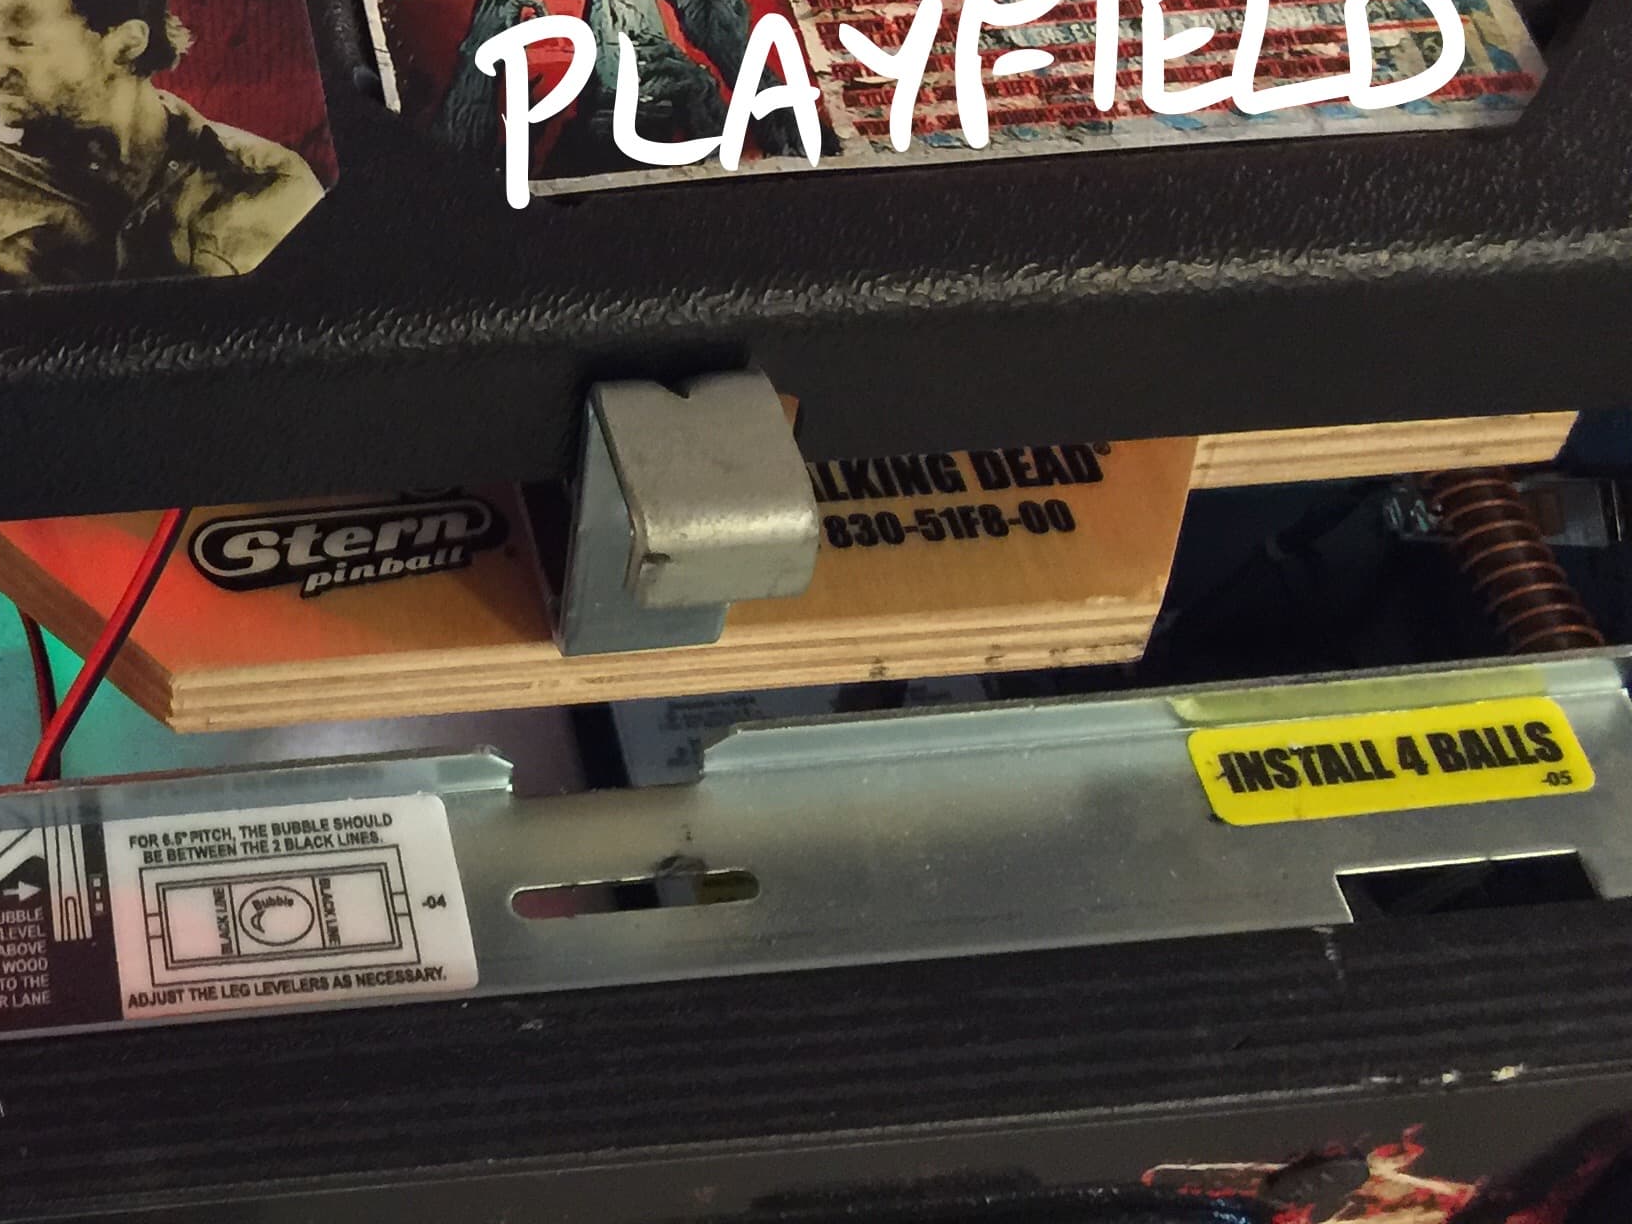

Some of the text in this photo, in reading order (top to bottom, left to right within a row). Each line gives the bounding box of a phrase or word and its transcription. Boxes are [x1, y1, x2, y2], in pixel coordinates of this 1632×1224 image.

[222, 511, 469, 577] Stern
[304, 545, 464, 592] pinball
[1216, 721, 1564, 794] INSTALL 4 BALLS
[129, 832, 159, 849] FOR
[189, 826, 237, 844] PITCH,
[238, 824, 269, 840] THE
[271, 818, 330, 837] BUBBLE
[333, 813, 394, 831] SHOULD
[143, 830, 384, 864] BE BETWEEN THE 2 BLACK LINES.
[251, 895, 295, 910] Bubble
[421, 893, 447, 909] -04
[2, 957, 49, 975] WOOD
[22, 974, 50, 989] THE
[12, 990, 51, 1009] LANE
[128, 965, 448, 1009] ADJUST THE LEG LEVELERS AS NECESSARY.
